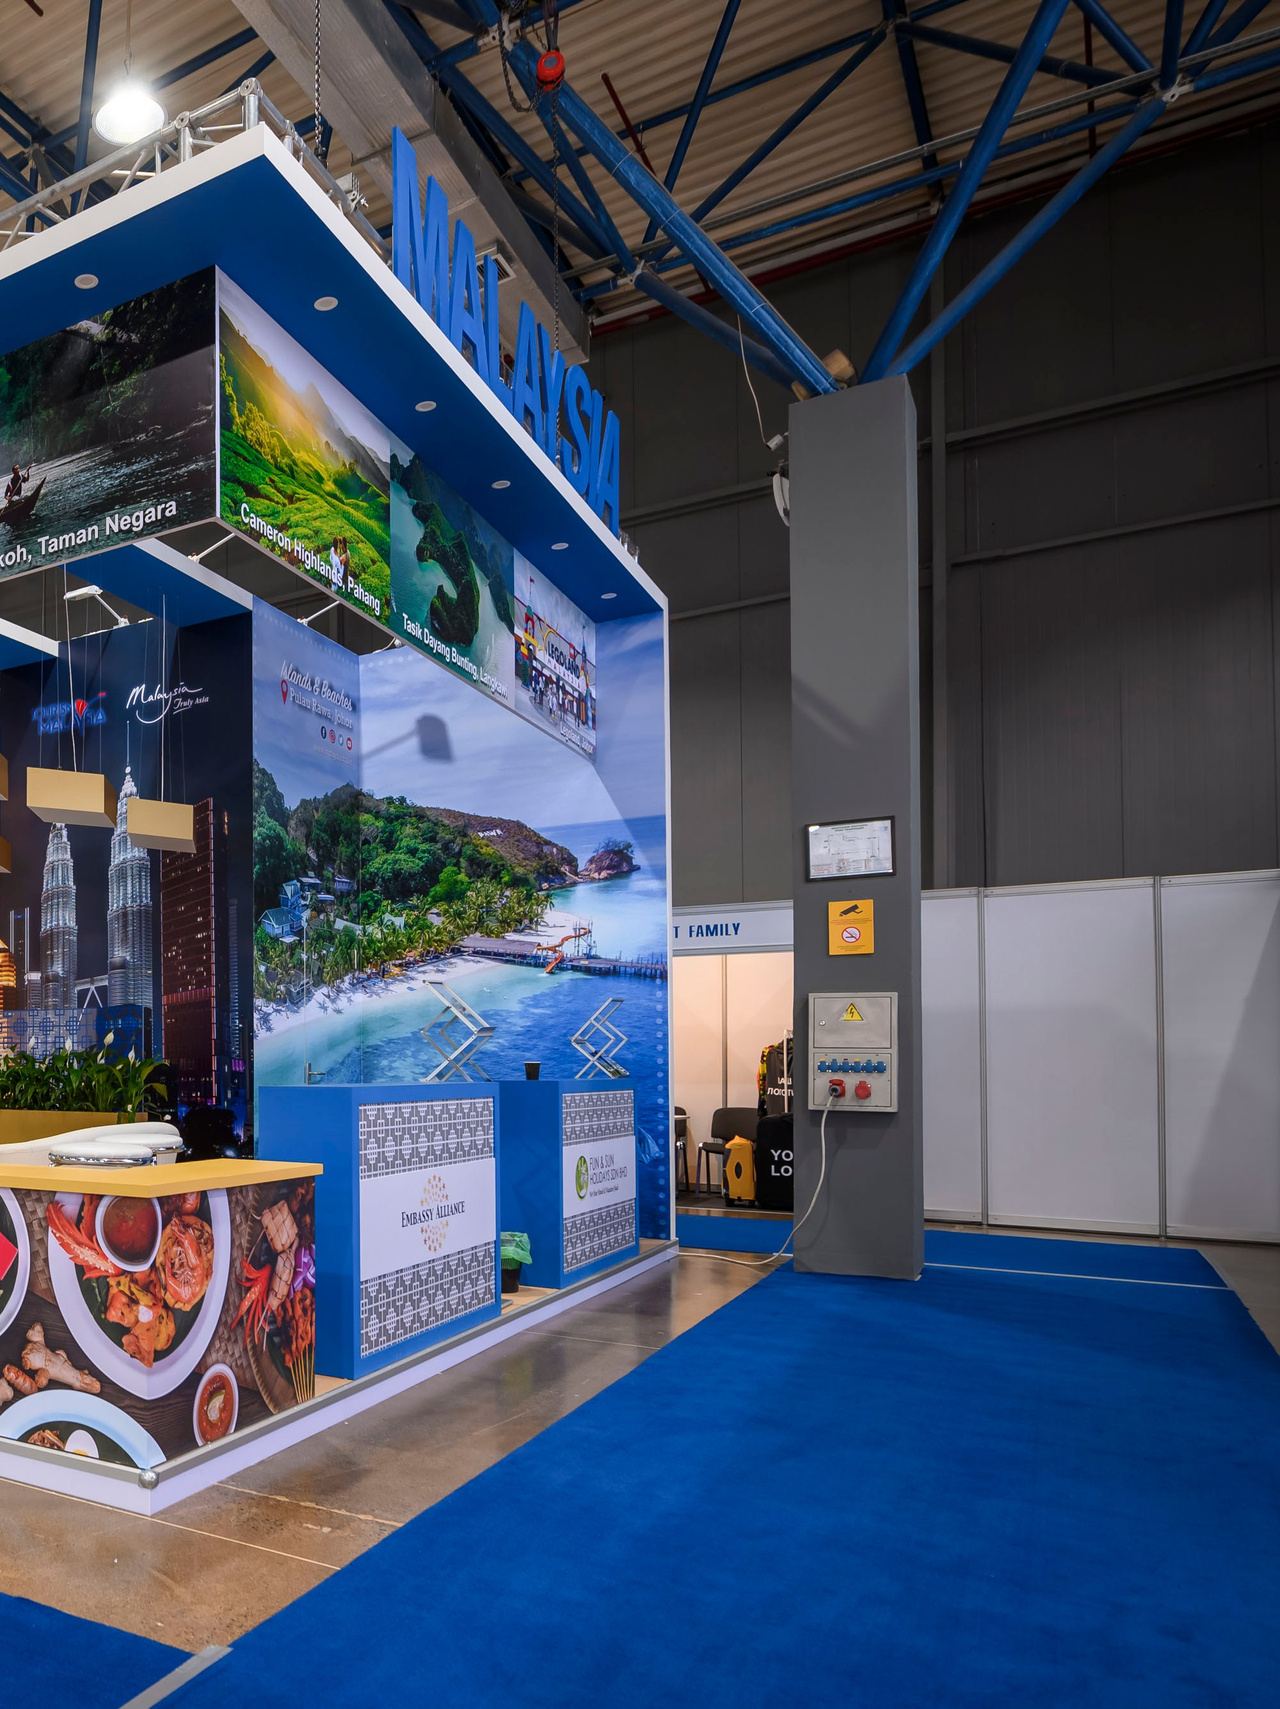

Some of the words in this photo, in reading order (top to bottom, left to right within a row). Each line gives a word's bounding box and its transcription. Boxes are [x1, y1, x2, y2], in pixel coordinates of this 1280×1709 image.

[392, 126, 620, 537] MALAYSIA
[37, 524, 99, 556] Taman
[105, 500, 177, 535] Negara
[240, 502, 291, 553] Cameron
[294, 537, 346, 592] Highlands,
[348, 575, 381, 616] Pahang
[402, 612, 422, 641] Tasik
[423, 627, 450, 662] Dayang
[480, 666, 508, 698] Langkawi
[547, 640, 580, 679] LEGOLAND
[126, 682, 203, 724] Malaysia
[280, 659, 312, 692] Islands
[313, 676, 321, 696] &
[321, 680, 353, 711] Beaches
[289, 687, 311, 709] Pulau
[334, 709, 353, 729] Johor
[673, 926, 680, 938] T
[689, 922, 740, 938] FAMILY
[401, 1208, 434, 1228] EMBASSY
[436, 1200, 465, 1219] ALLIANCE
